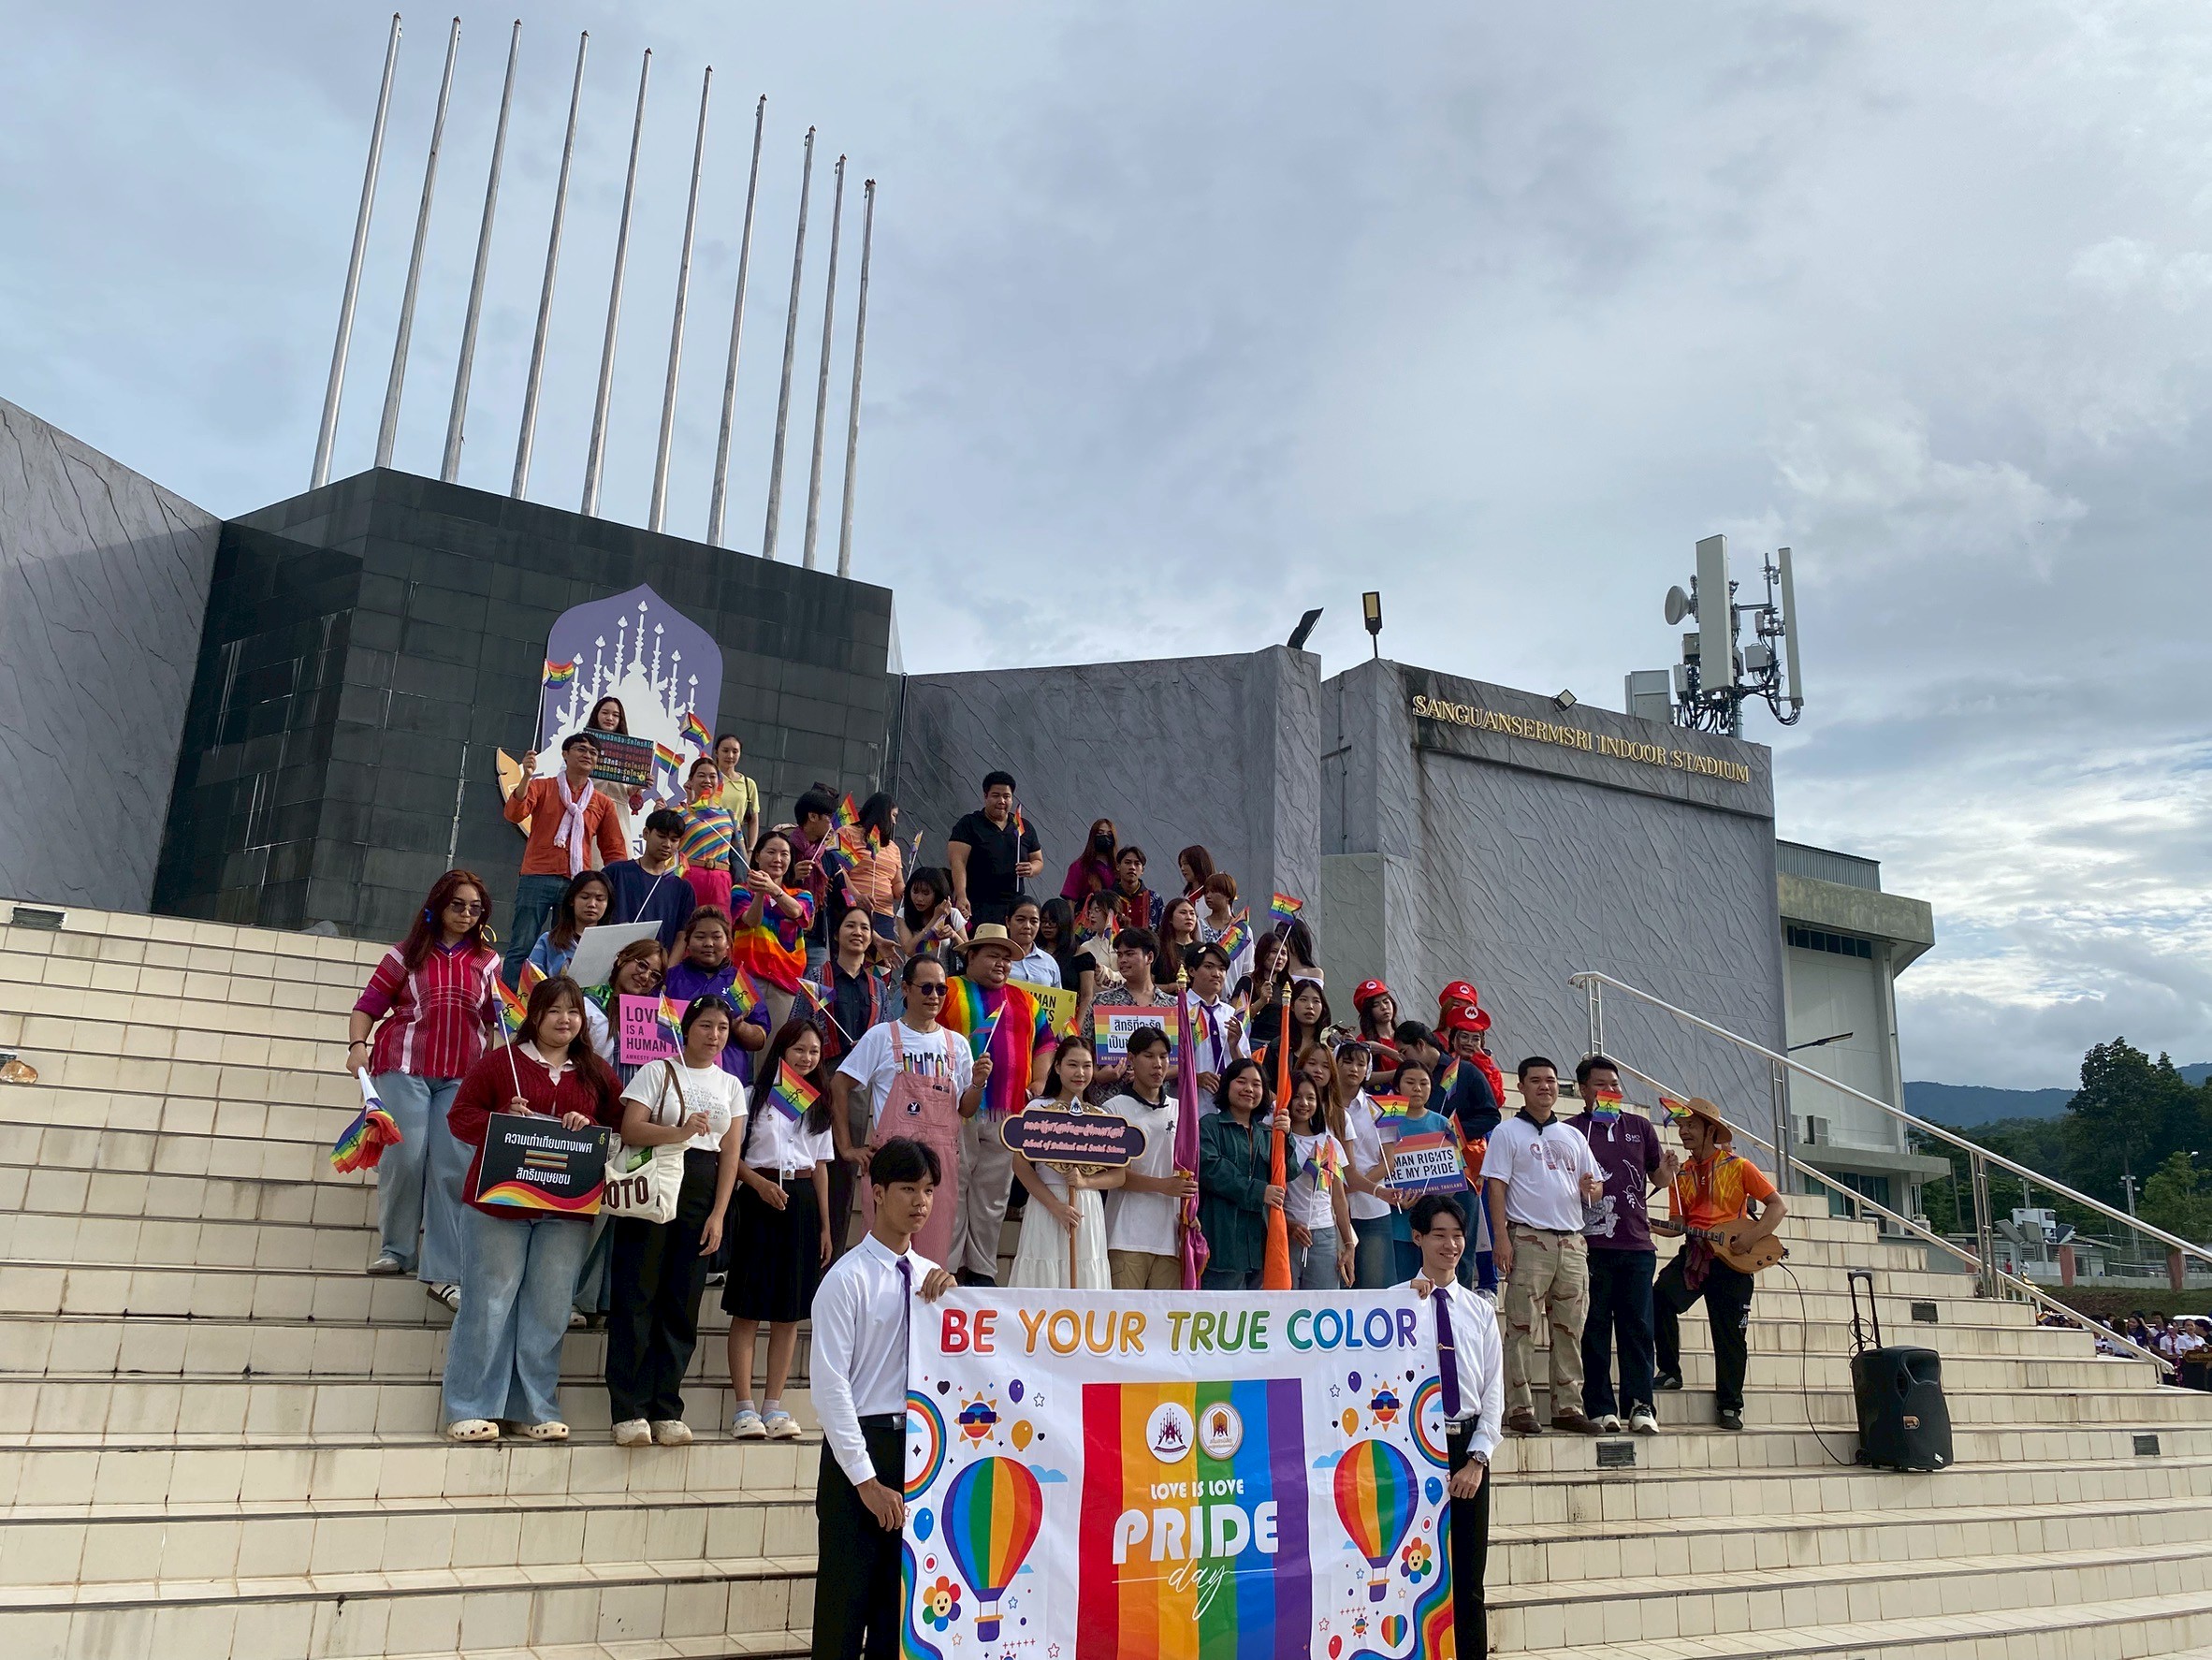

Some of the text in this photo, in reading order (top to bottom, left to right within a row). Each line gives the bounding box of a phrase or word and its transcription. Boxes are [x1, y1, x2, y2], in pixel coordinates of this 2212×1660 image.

[1412, 695, 1750, 784] SANGUANSERMSRI INDOOR STADIUM
[626, 1025, 645, 1036] IS A
[626, 1038, 667, 1053] HUMAN
[504, 1132, 593, 1154] ความเท่าเทียมทางเพศ
[1022, 1139, 1043, 1148] School
[1043, 1140, 1052, 1151] of
[1050, 1141, 1077, 1151] Political
[1076, 1143, 1088, 1152] and
[1088, 1143, 1106, 1153] Social
[1394, 1149, 1454, 1167] MAN RIGHTS
[516, 1167, 571, 1186] สิทธิมนุษยชน
[1405, 1166, 1419, 1179] MY
[1423, 1162, 1455, 1176] PRIDE
[601, 1175, 649, 1209] OTO
[939, 1307, 1418, 1354] BE YOUR TRUE COLOR
[1150, 1478, 1244, 1500] LOVE IS LOVE
[1113, 1500, 1279, 1565] PRIDE
[1168, 1558, 1230, 1621] day
